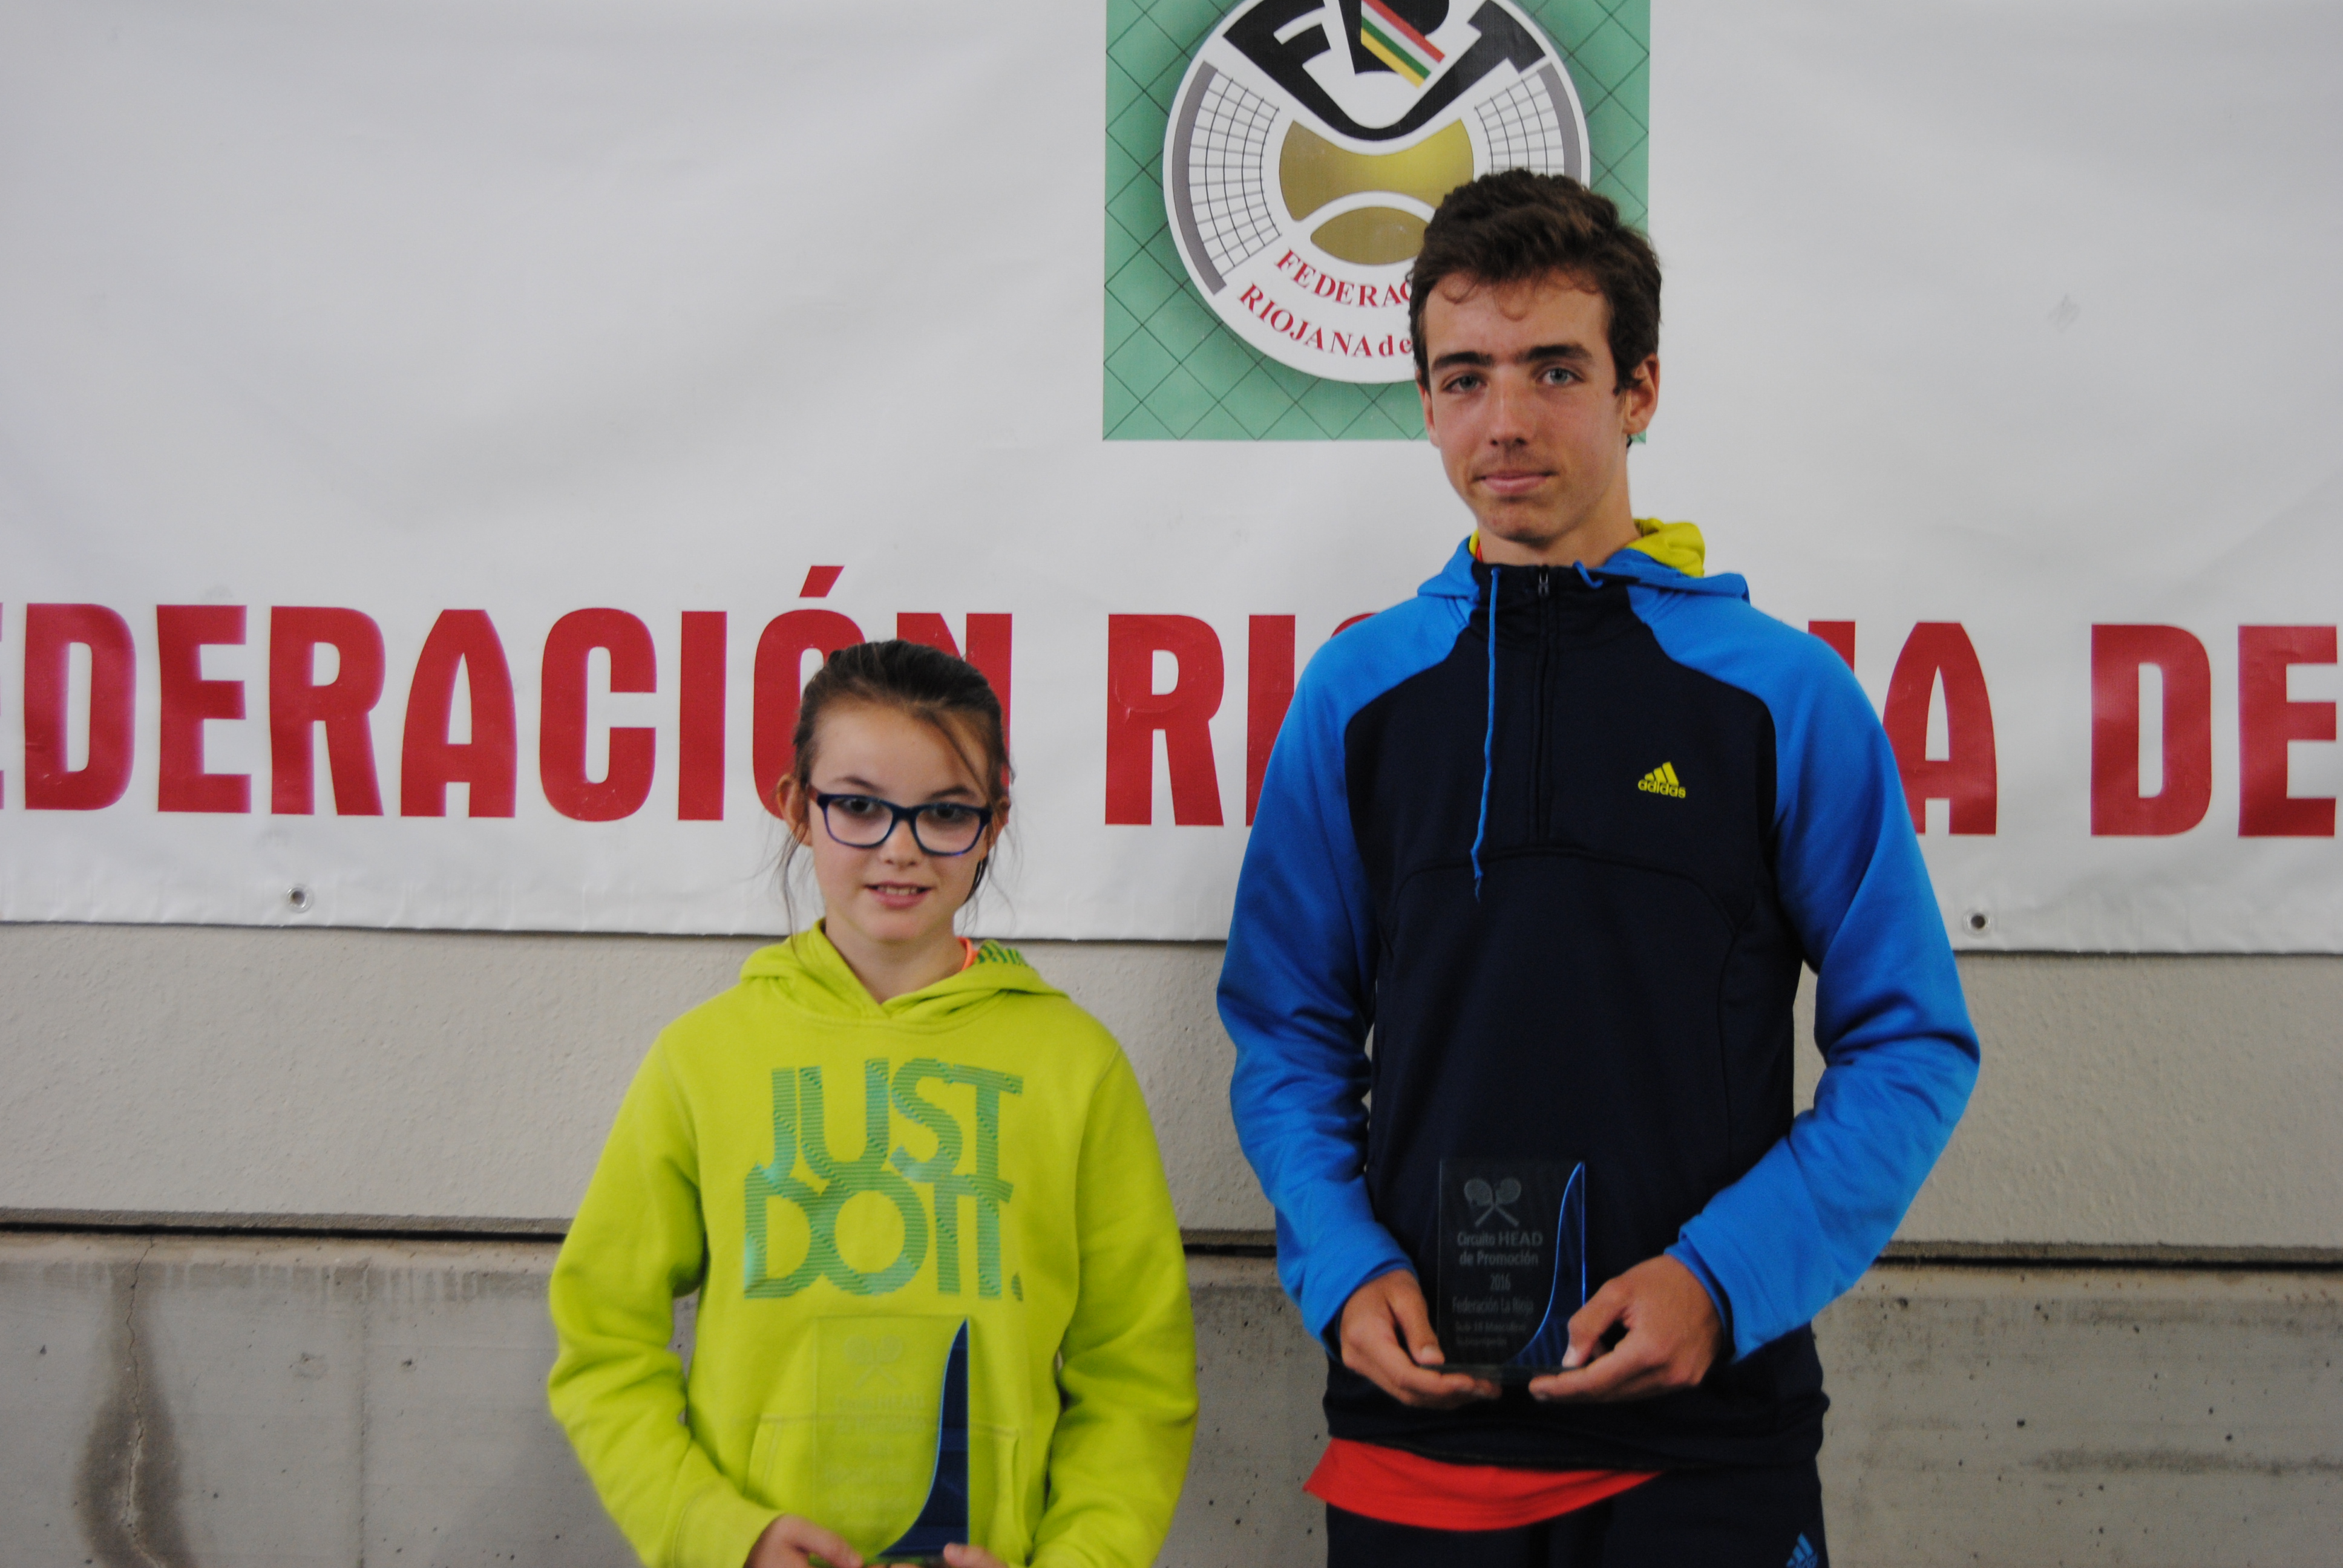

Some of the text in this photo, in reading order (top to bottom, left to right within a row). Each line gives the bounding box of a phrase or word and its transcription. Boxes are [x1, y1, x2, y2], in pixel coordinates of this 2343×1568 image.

[1275, 247, 1411, 308] FEDERAC
[1238, 281, 1373, 358] RIOJANA
[2091, 624, 2338, 837] DE
[1637, 779, 1686, 799] adidas
[754, 1057, 1024, 1184] JUST
[744, 1165, 929, 1300] DO
[1457, 1230, 1544, 1246] Circuito HEAD
[1459, 1248, 1539, 1266] de Promoción
[1490, 1272, 1512, 1292] 2016
